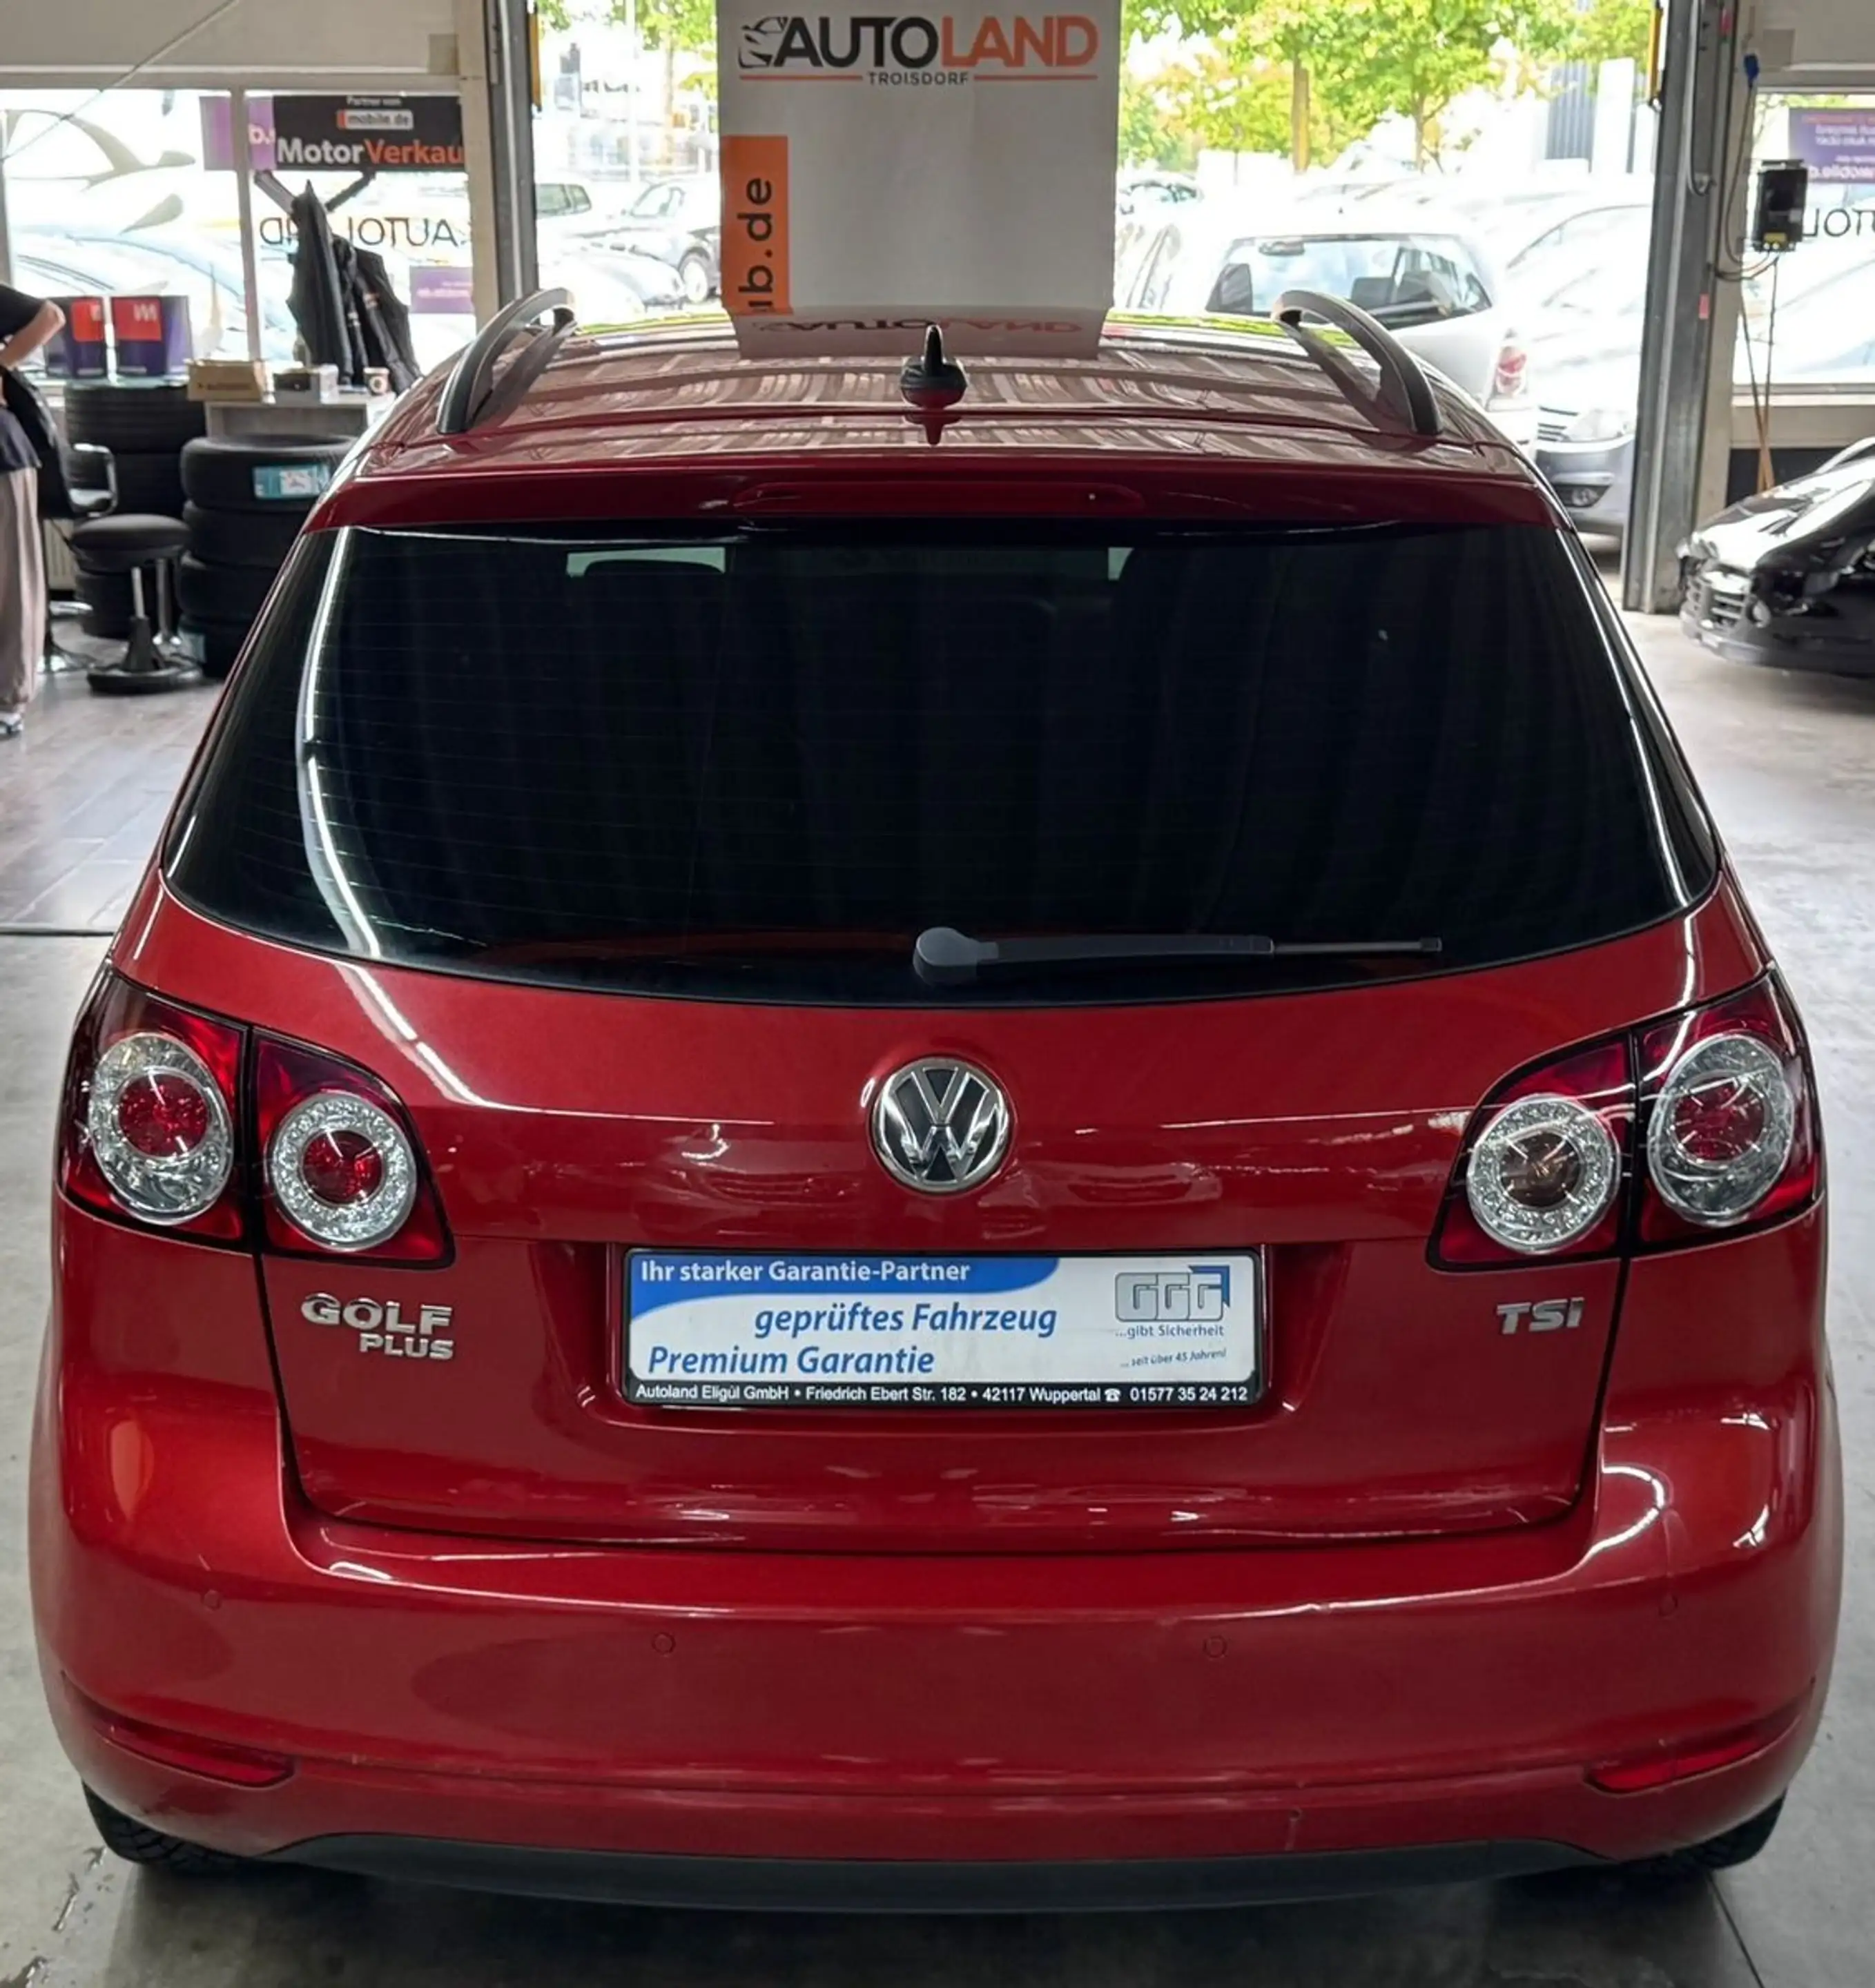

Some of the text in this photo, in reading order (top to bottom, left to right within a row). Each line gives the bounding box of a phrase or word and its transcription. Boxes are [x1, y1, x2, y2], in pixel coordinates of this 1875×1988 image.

[773, 15, 1099, 68] AUTOLAND
[868, 71, 969, 86] TROISDORF
[641, 1260, 971, 1282] Ihr starker Garantie-Partner
[300, 1292, 453, 1335] GOLF
[755, 1301, 1058, 1338] geprüftes Fahrzeug
[1158, 1324, 1225, 1337] Sicherheit
[359, 1332, 454, 1361] PLUS
[648, 1345, 935, 1374] Premium Garantie
[635, 1384, 698, 1399] Autoland
[744, 1385, 789, 1400] GmbH
[806, 1385, 867, 1401] Friedrich
[871, 1386, 909, 1401] Ebert
[911, 1386, 935, 1401] Str.
[941, 1387, 966, 1401] 182
[982, 1387, 1027, 1401] 42117
[1029, 1387, 1101, 1404] Wuppertal
[1129, 1386, 1174, 1401] 01577
[1177, 1386, 1196, 1401] 35
[1199, 1386, 1217, 1401] 24
[1220, 1386, 1248, 1401] 212
